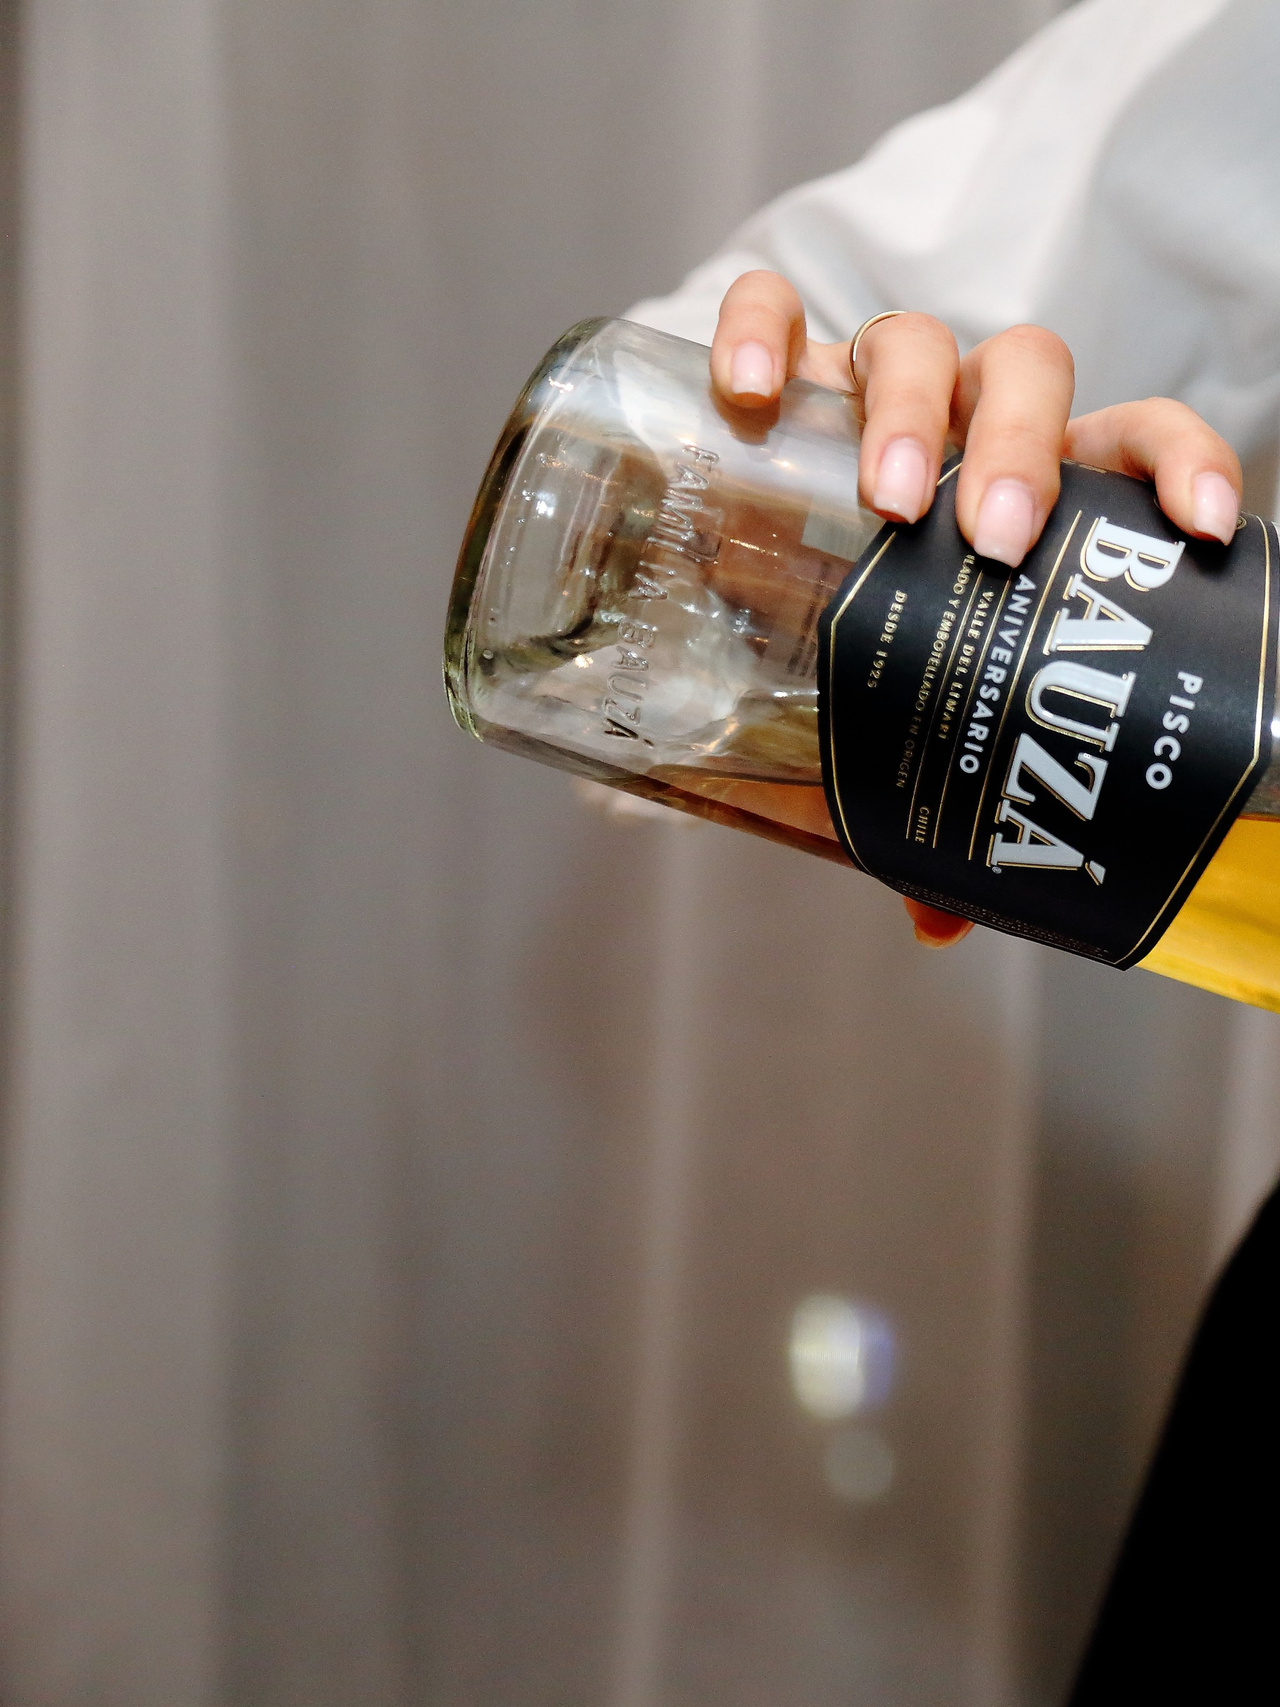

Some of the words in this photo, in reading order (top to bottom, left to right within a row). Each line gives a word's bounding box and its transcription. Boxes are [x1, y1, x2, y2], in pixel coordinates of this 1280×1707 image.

[627, 444, 720, 600] FAMILIA
[880, 589, 908, 644] DESDE
[948, 599, 961, 609] Y
[967, 591, 995, 640] VALLE
[601, 616, 658, 748] BAUZÁ
[867, 650, 888, 688] 1925
[915, 610, 957, 712] EMBOTELLADO
[955, 644, 976, 676] DEL
[959, 574, 1037, 774] ANIVERSARIO
[909, 716, 922, 735] EN
[986, 516, 1186, 885] BAUZÁ
[1146, 671, 1204, 790] PISCO
[896, 739, 915, 788] ORIGEN
[914, 806, 930, 844] CHILE
